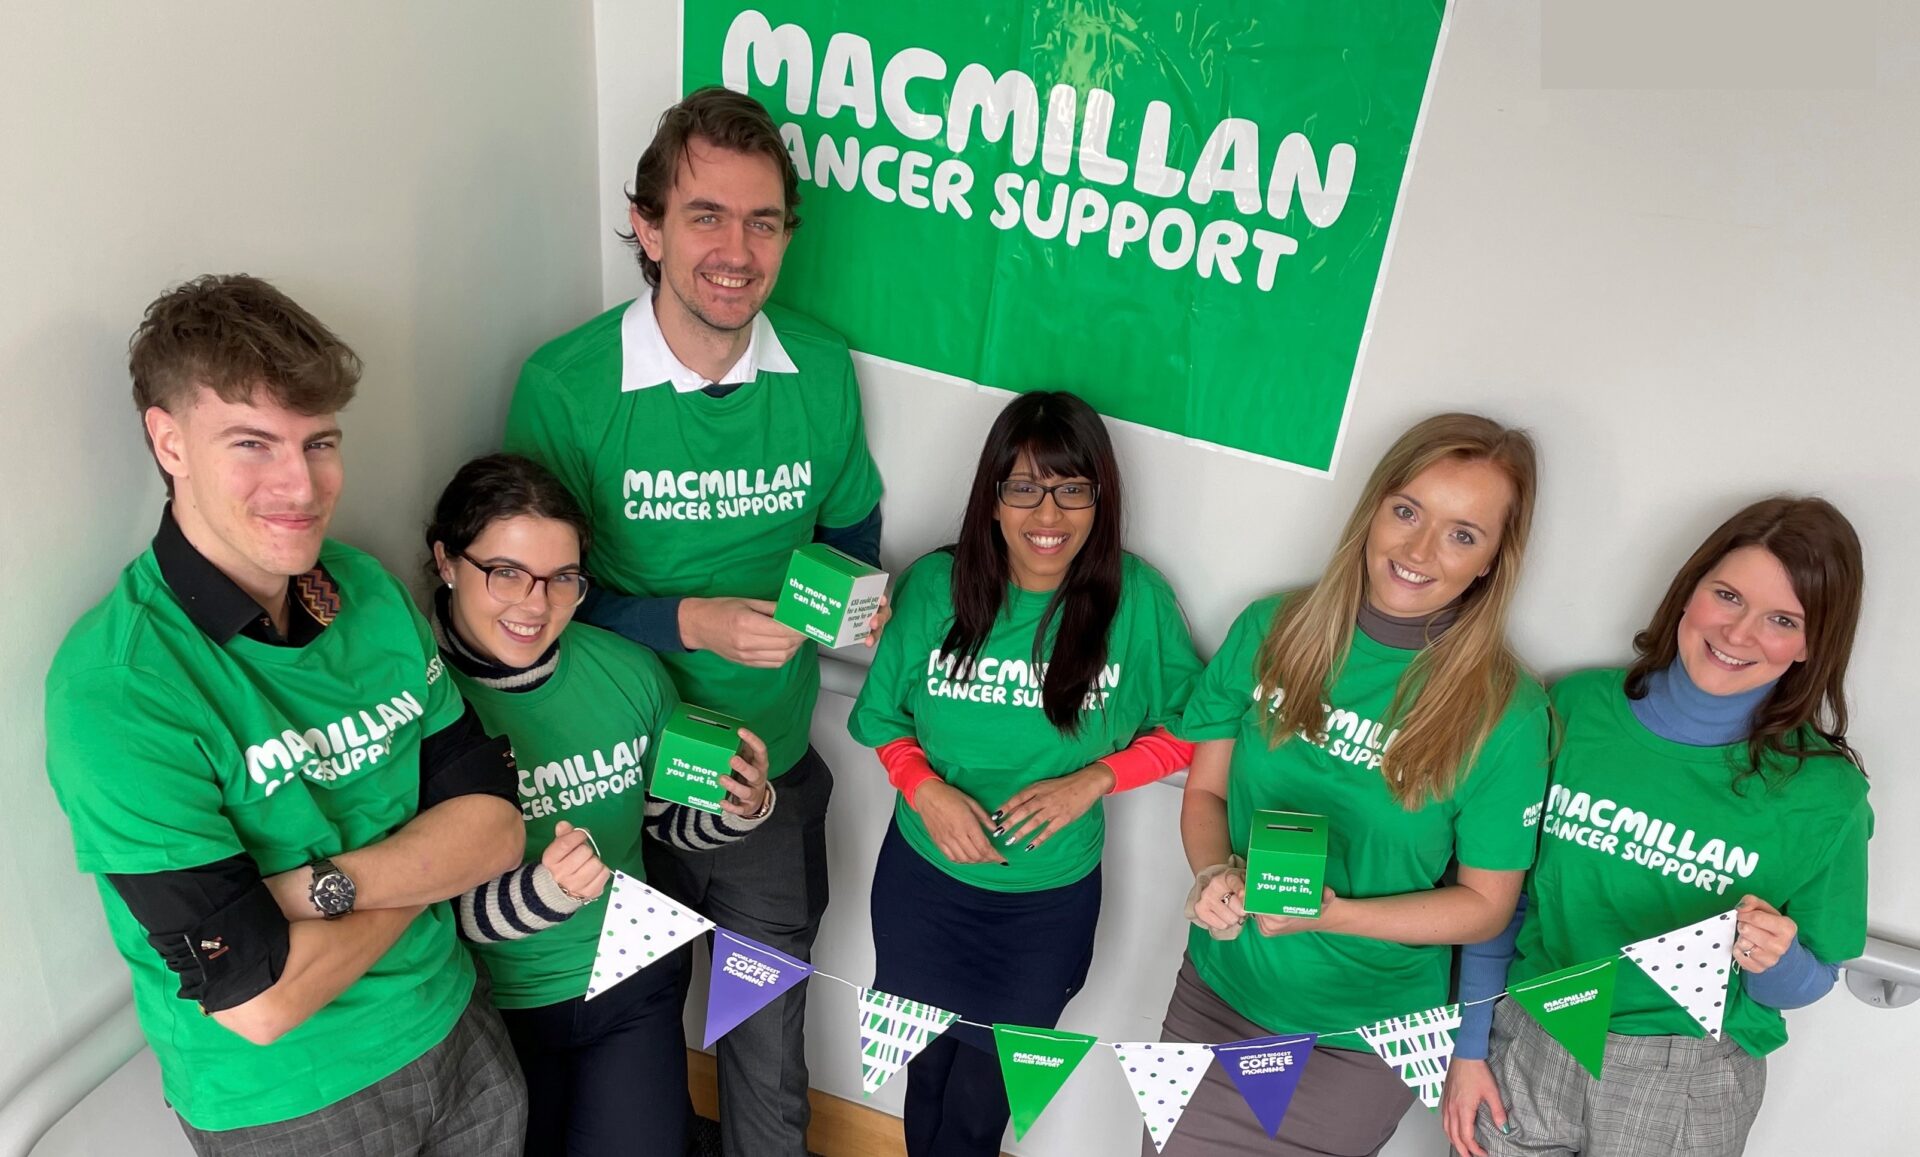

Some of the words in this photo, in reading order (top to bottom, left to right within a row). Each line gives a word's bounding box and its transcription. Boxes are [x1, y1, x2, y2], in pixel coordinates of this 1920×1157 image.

[721, 9, 1357, 229] MACMILLAN
[779, 122, 974, 220] ANCER
[989, 172, 1299, 292] SUPPORT
[623, 460, 812, 500] MACMILLAN
[624, 500, 712, 521] CANCER
[716, 490, 806, 519] SUPPORT
[789, 577, 804, 591] the
[805, 587, 828, 602] more
[828, 597, 842, 609] we
[793, 592, 809, 605] can
[810, 598, 831, 616] help.
[927, 677, 1007, 705] CANCER
[1012, 688, 1109, 710] SURT
[245, 690, 424, 784] MAMILLAN
[518, 735, 648, 797] CMILLAN
[672, 757, 690, 769] The
[692, 765, 718, 777] more
[1328, 739, 1384, 770] SUPP
[666, 767, 685, 778] you
[686, 773, 704, 783] put
[706, 776, 718, 789] in,
[521, 796, 558, 821] CER
[1546, 783, 1759, 878] MACMILLAN
[1543, 814, 1619, 855] CANCER
[1621, 841, 1734, 896] SUPPORT
[1257, 882, 1276, 890] you
[1279, 884, 1297, 893] put
[1300, 885, 1313, 895] in,
[1262, 872, 1280, 882] The
[1283, 874, 1310, 885] more
[723, 965, 764, 987] MORNING
[726, 956, 779, 985] COFFEE
[1544, 989, 1598, 1009] MACMILLAN
[1013, 1052, 1064, 1064] MACMILLAN
[1239, 1056, 1293, 1070] COFFEE
[1242, 1066, 1285, 1076] MORNING
